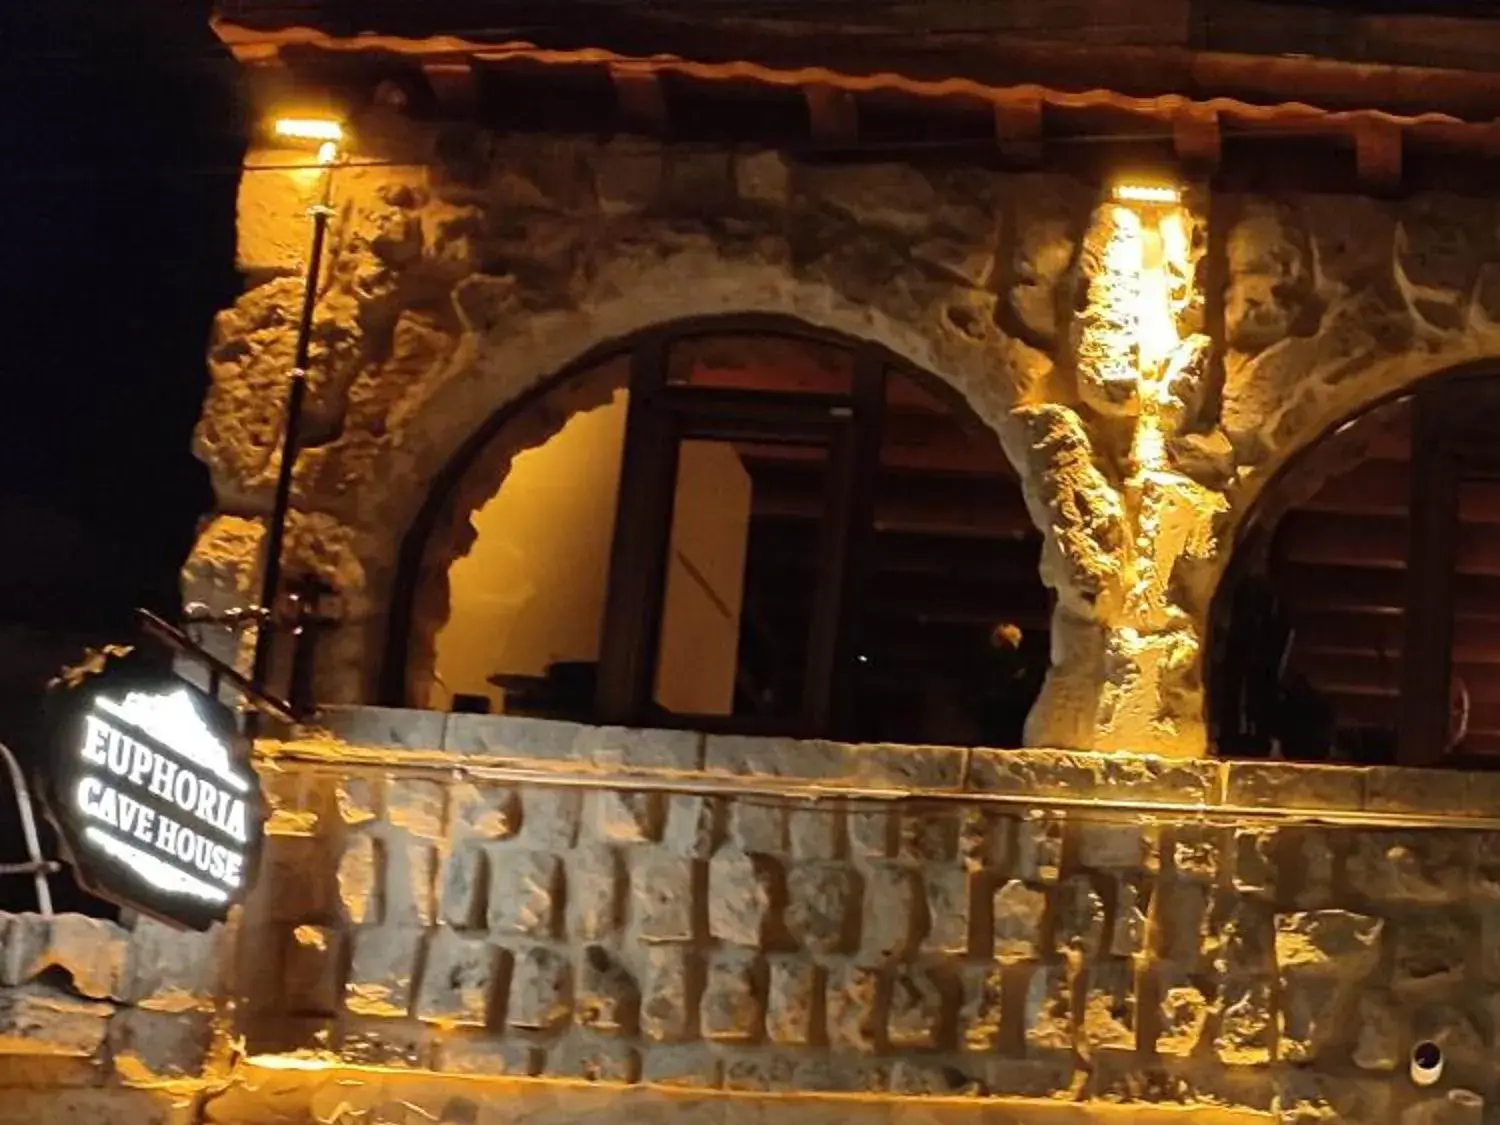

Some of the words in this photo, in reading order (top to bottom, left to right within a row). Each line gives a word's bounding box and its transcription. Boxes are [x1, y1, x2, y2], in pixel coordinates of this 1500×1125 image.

[78, 776, 156, 843] CAVE
[156, 815, 243, 888] HOUSE
[80, 714, 248, 843] EUPHORIA
